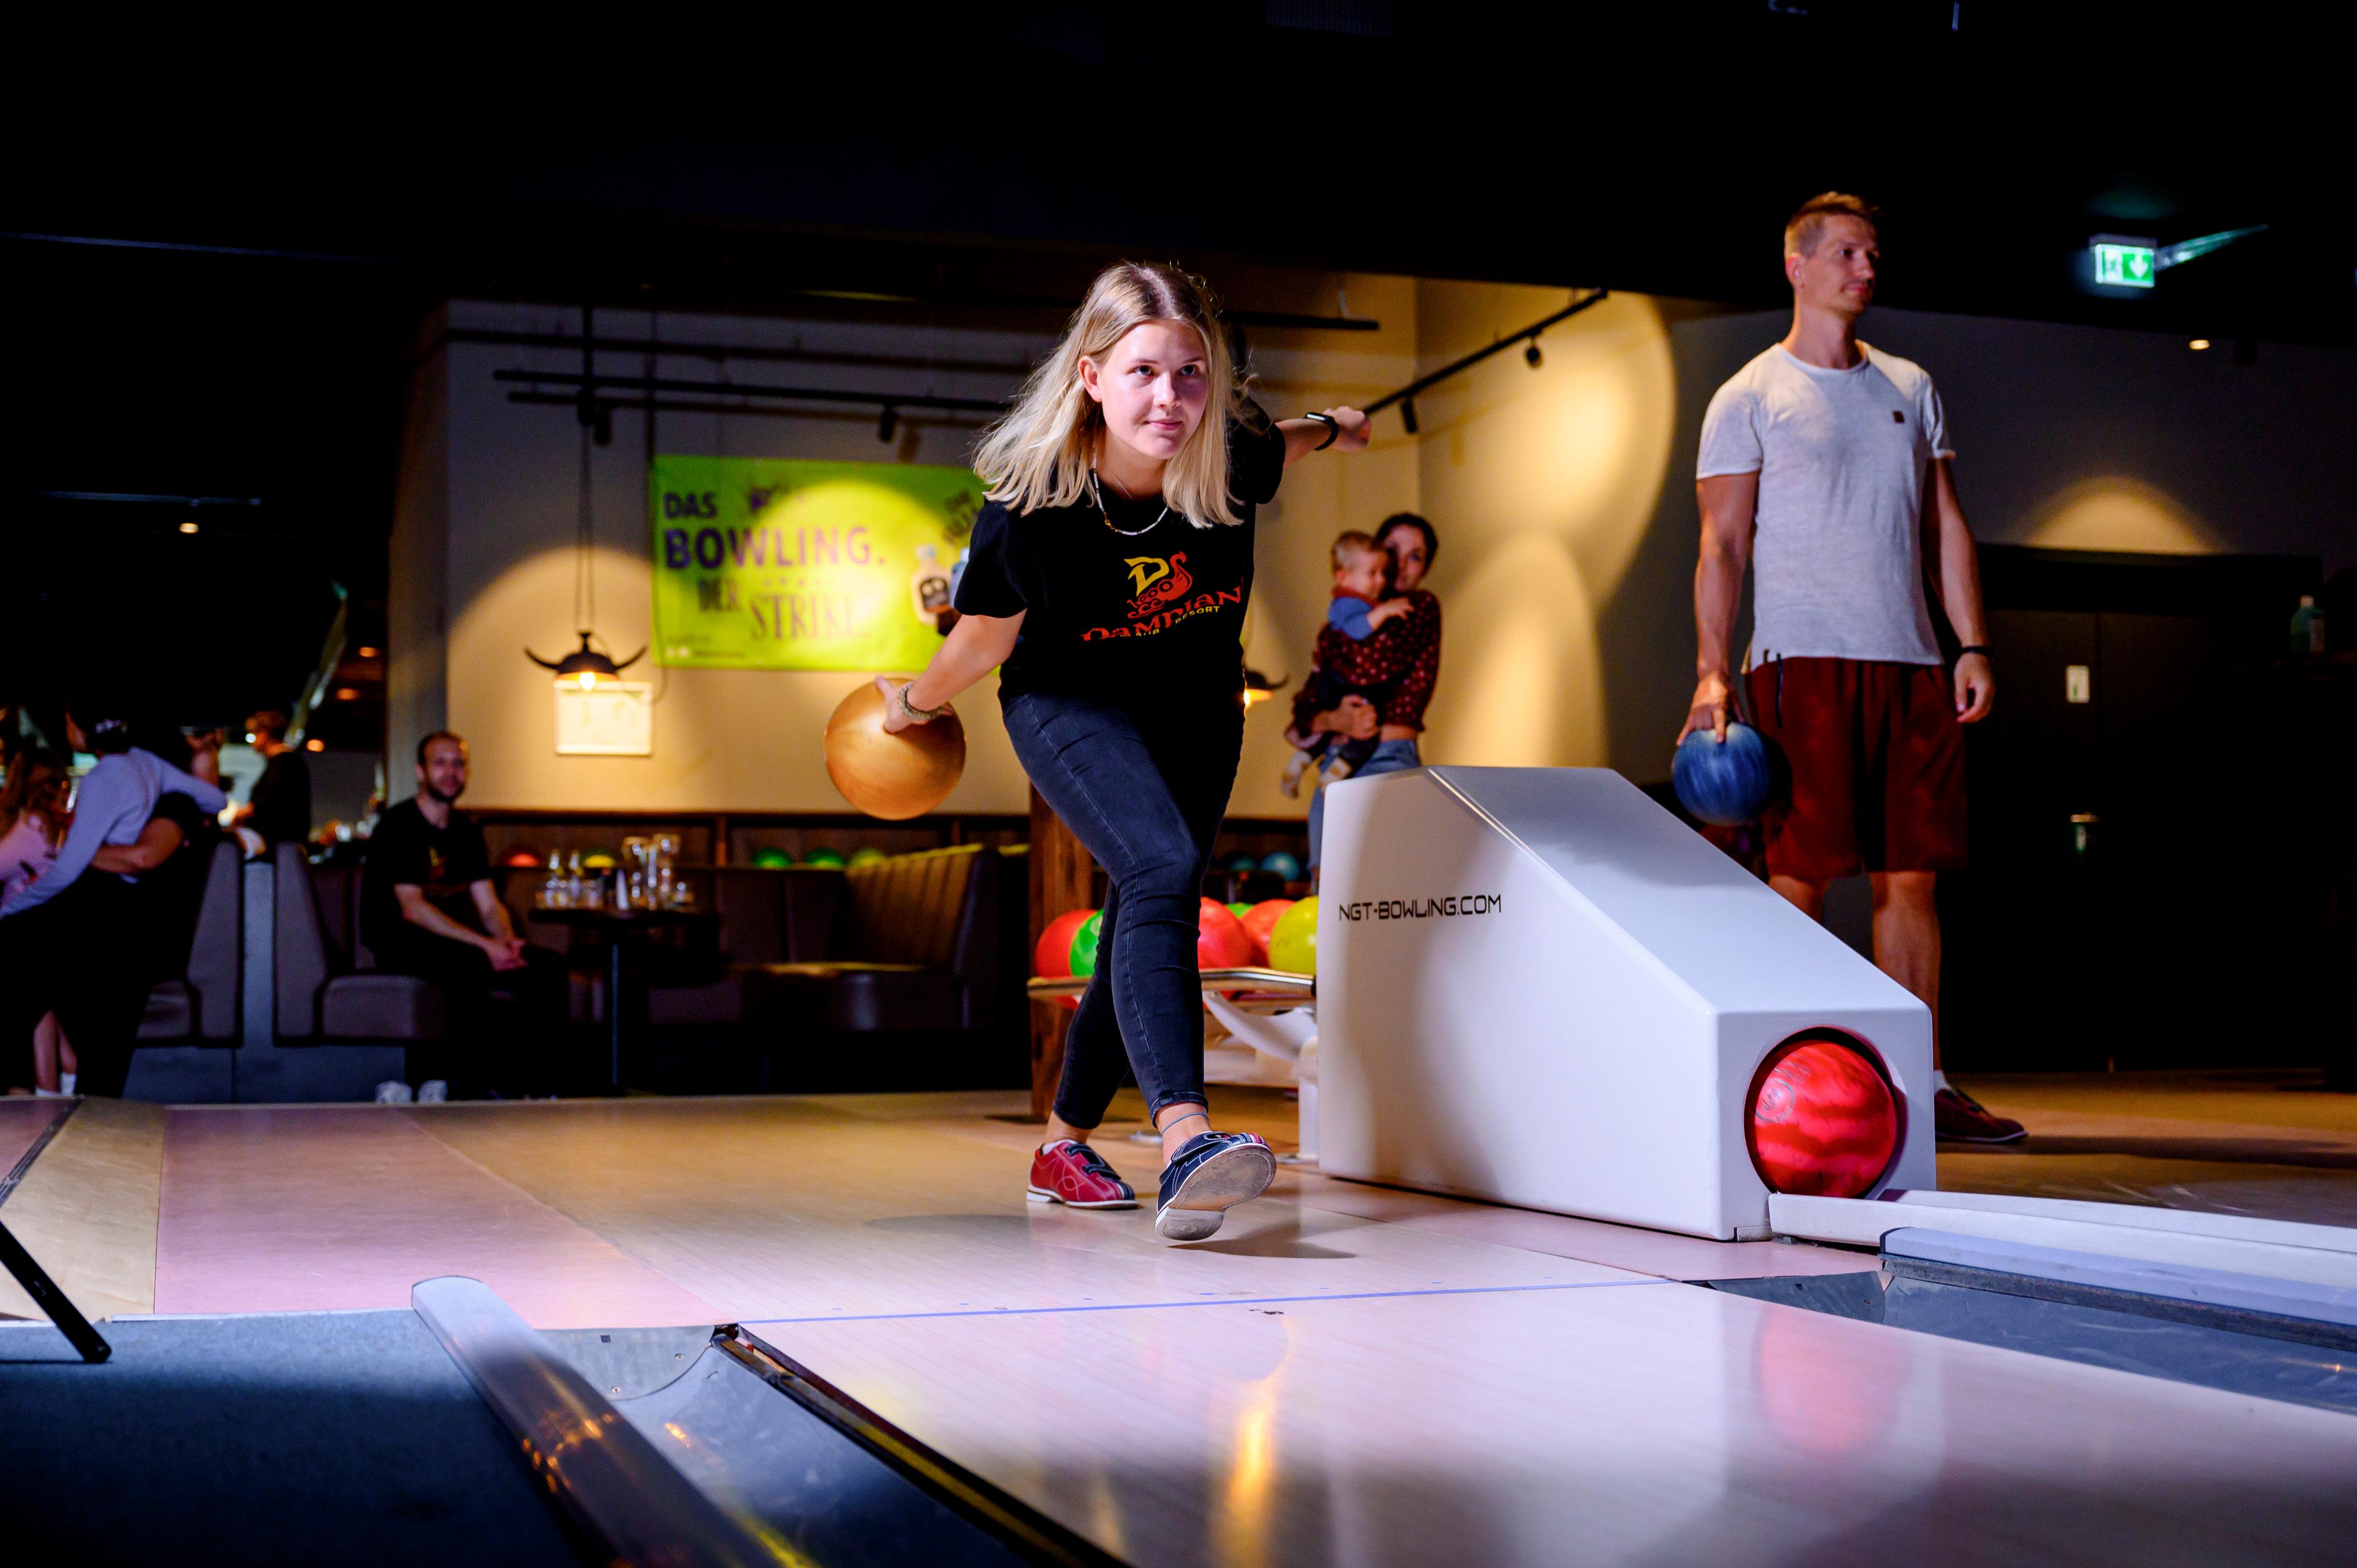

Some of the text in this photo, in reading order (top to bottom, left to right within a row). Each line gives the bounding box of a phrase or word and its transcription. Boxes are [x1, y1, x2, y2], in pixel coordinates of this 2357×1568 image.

[664, 492, 717, 519] DAS
[664, 525, 886, 569] BOWLING.
[1339, 894, 1501, 921] NGT-BOWLING.COM
